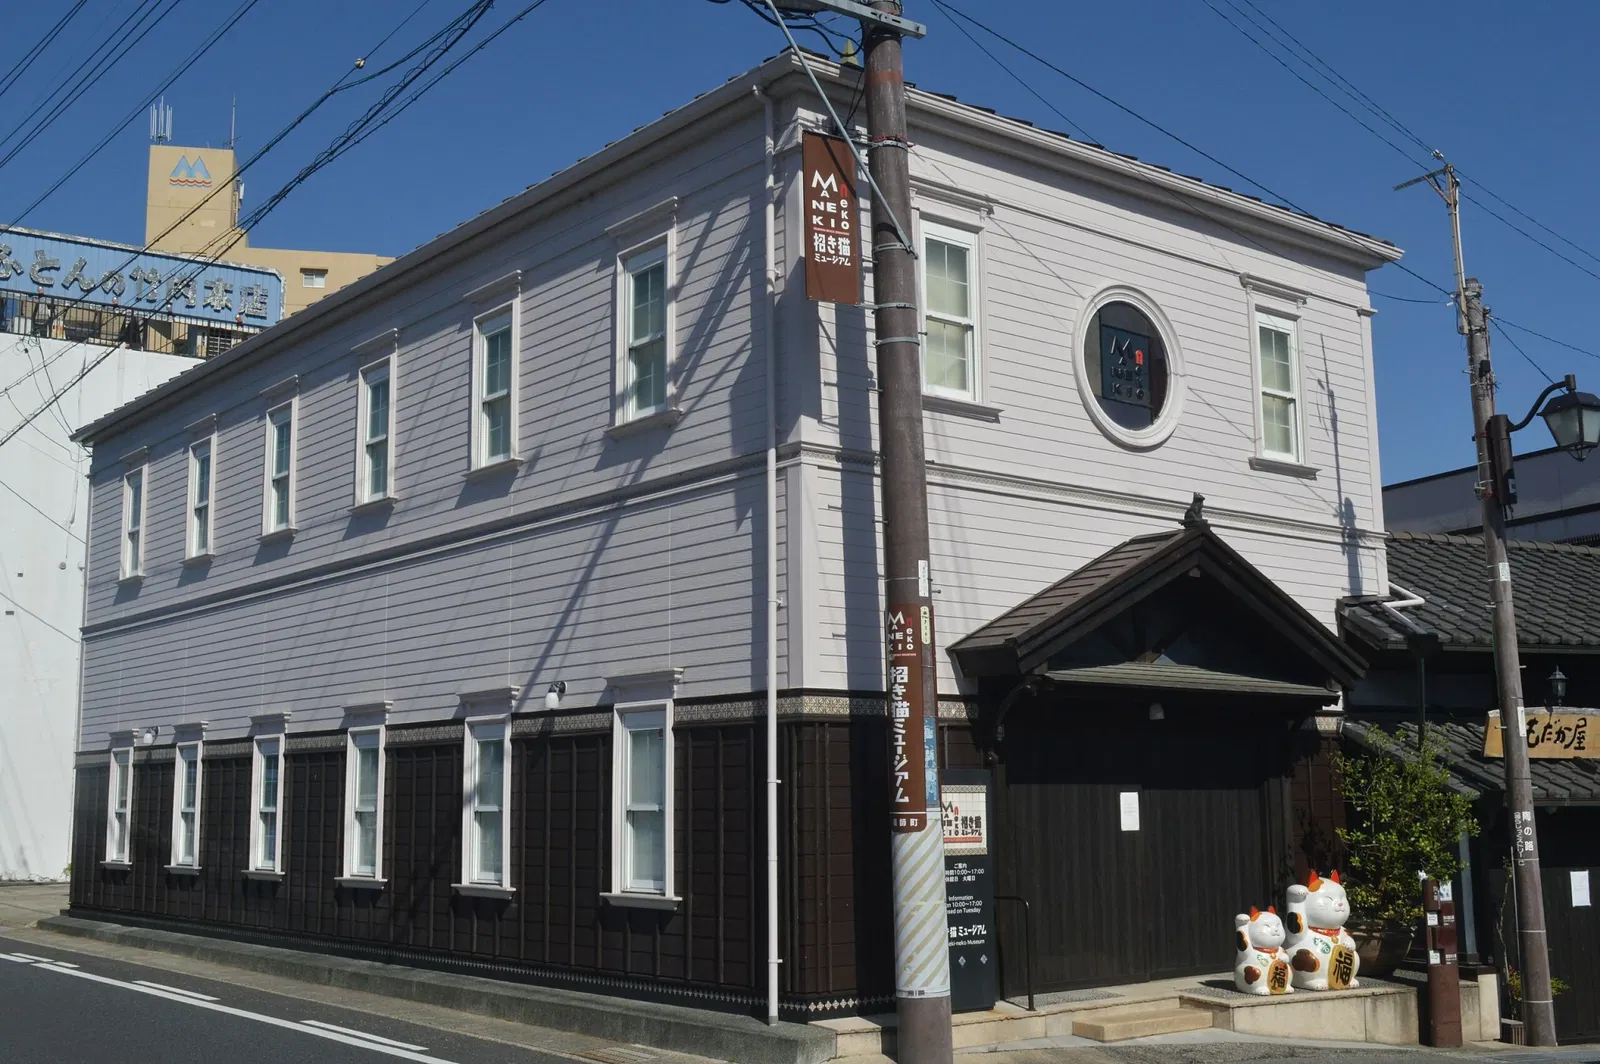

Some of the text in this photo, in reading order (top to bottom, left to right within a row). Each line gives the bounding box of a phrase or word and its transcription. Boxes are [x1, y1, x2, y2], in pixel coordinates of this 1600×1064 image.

[813, 232, 851, 257] 招き猫
[814, 253, 851, 266] ミュージアム
[890, 666, 910, 802] 招き猫ミュージアム
[961, 816, 982, 829] 招き猫
[1333, 950, 1353, 986] 福
